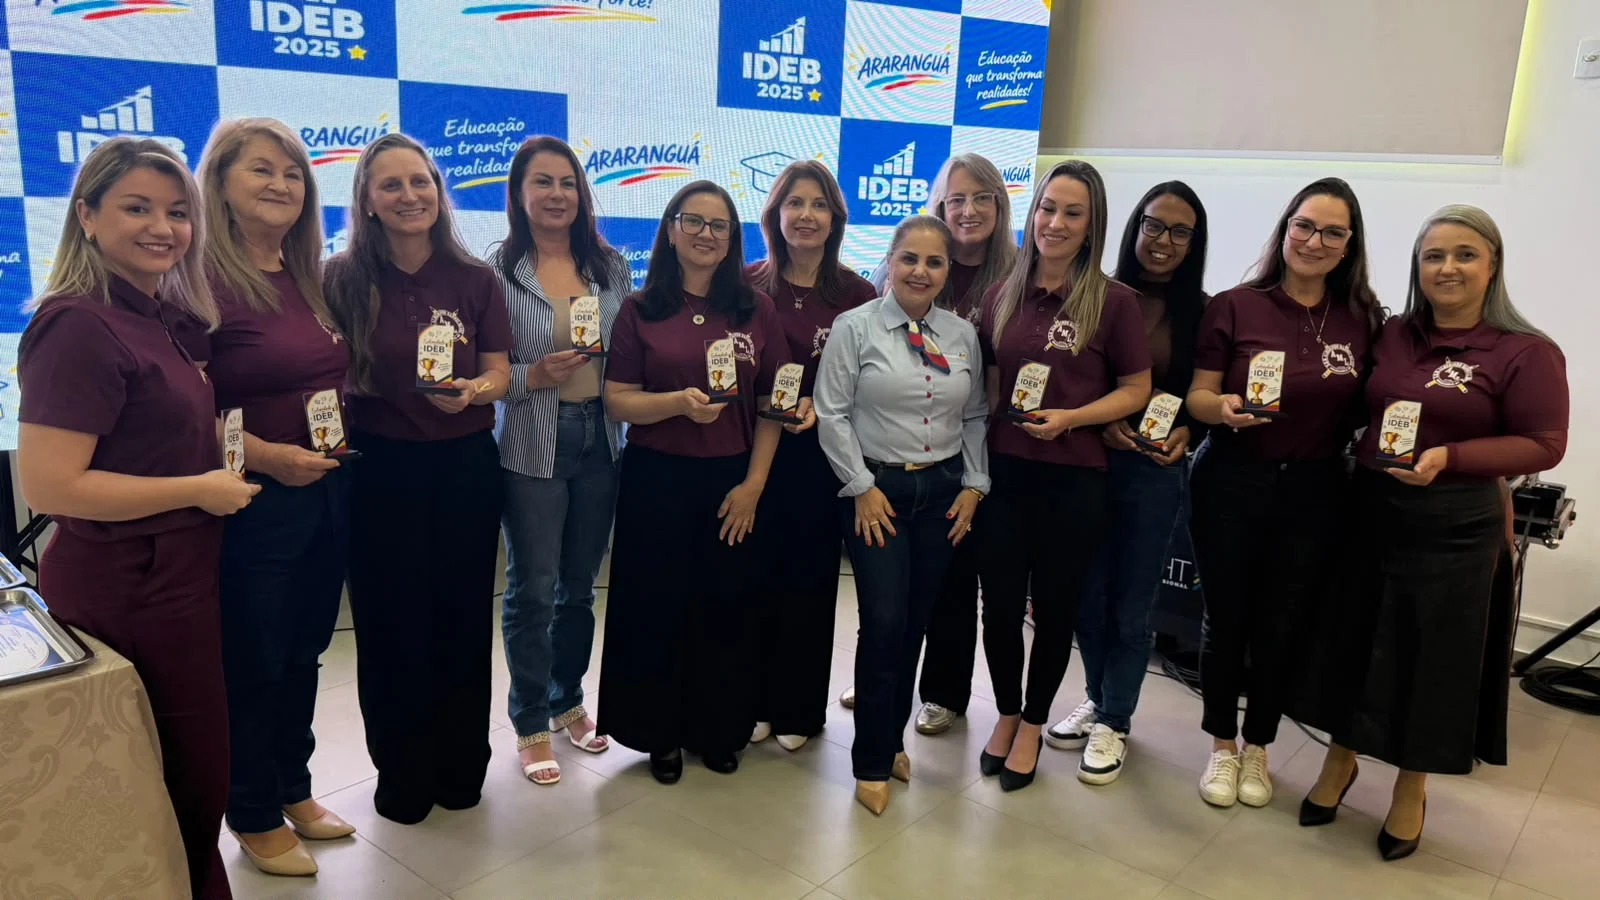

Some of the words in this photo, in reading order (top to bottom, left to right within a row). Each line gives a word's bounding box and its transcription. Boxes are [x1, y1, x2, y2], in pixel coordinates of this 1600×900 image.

[250, 0, 365, 39] IDEB
[273, 36, 340, 58] 2025
[857, 52, 950, 80] ARARANGUÁ
[978, 50, 1032, 67] Educação
[743, 52, 821, 85] IDEB
[965, 73, 984, 88] que
[986, 67, 1043, 84] transforma
[757, 83, 804, 101] 2025
[976, 82, 1033, 100] realidades!
[300, 122, 388, 147] RANGUÁ
[444, 117, 525, 137] Educação
[458, 137, 522, 156] transfo
[585, 141, 701, 174] ARARANGUÁ
[446, 157, 515, 177] realidad
[1002, 163, 1032, 183] NGUÁ
[858, 176, 928, 202] IDEB
[870, 202, 912, 216] 2025
[423, 344, 445, 353] IDEB
[711, 357, 729, 365] IDEB
[1254, 369, 1275, 377] IDEB
[778, 379, 795, 387] IDEB
[1020, 378, 1038, 388] IDEB
[313, 411, 333, 421] IDEB
[1151, 407, 1169, 418] IDEB
[1387, 419, 1410, 428] IDEB
[1162, 579, 1188, 590] SIONAL
